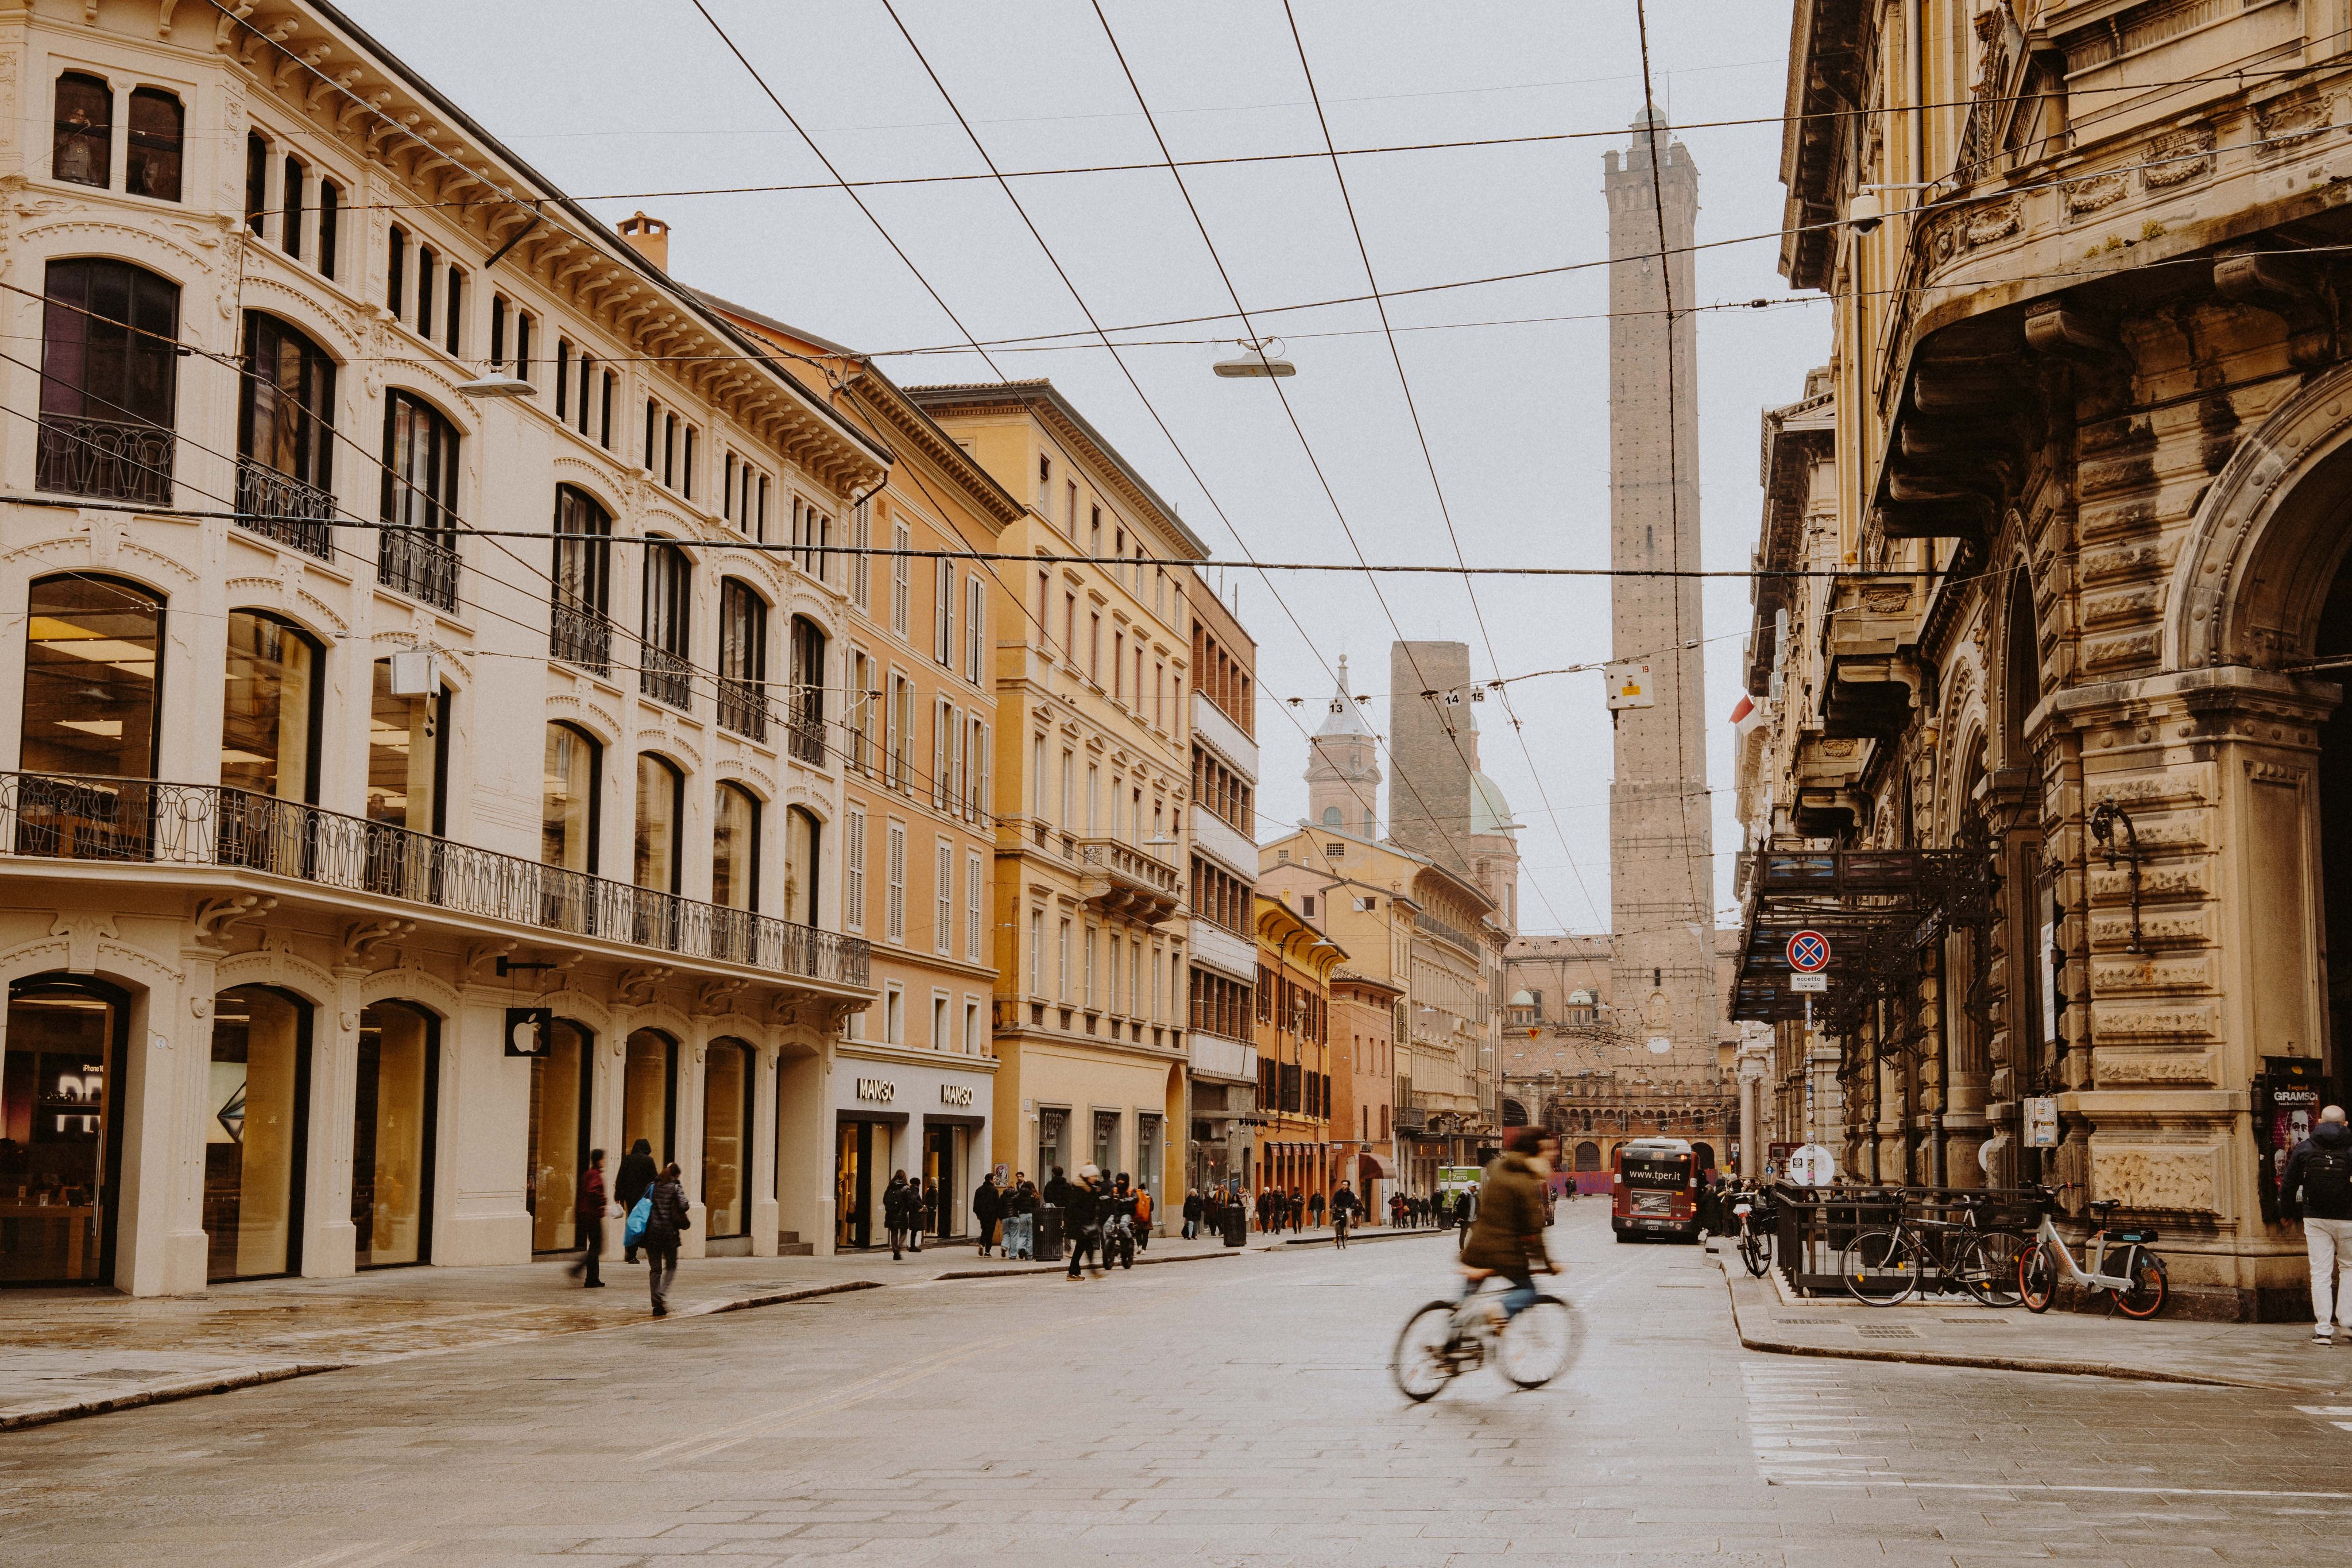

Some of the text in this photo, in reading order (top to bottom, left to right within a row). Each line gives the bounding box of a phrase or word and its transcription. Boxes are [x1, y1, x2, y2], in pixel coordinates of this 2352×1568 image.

[1445, 695, 1460, 705] 14
[1471, 692, 1484, 702] 15
[1329, 704, 1343, 713] 13
[858, 1078, 895, 1101] MANGO
[942, 1085, 973, 1105] MANGO
[1630, 1171, 1681, 1181] www.tper.it
[2052, 1240, 2073, 1270] ridemovi
